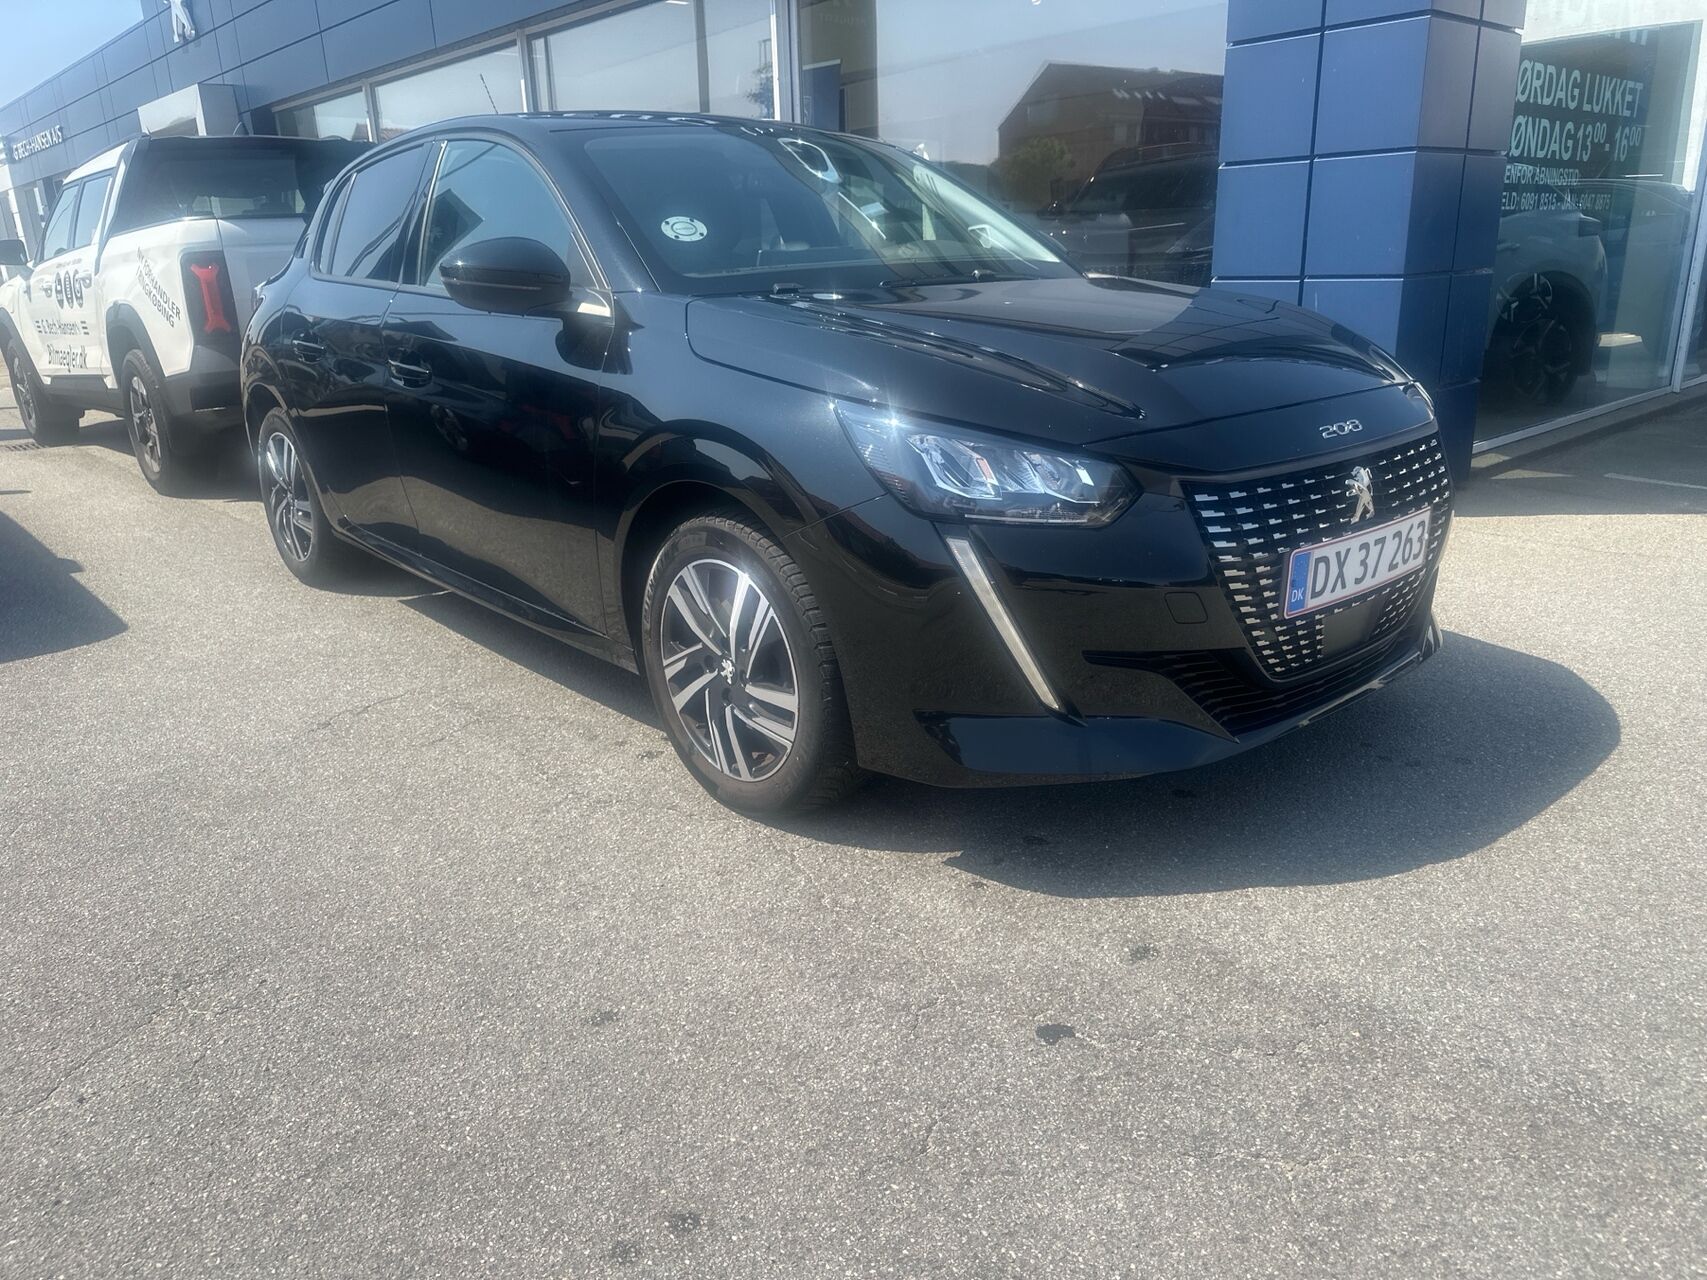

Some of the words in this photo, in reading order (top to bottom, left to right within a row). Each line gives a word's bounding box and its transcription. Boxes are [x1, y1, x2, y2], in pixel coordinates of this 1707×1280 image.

[1516, 59, 1581, 110] ØRDAG
[1583, 73, 1644, 118] LUKKET
[1509, 115, 1575, 160] ØNDAG
[1504, 164, 1533, 184] ENFOR
[1319, 419, 1363, 439] 208
[1310, 547, 1351, 600] DX
[1354, 535, 1386, 585] 37
[1388, 520, 1426, 572] 263
[1291, 588, 1304, 603] DK
